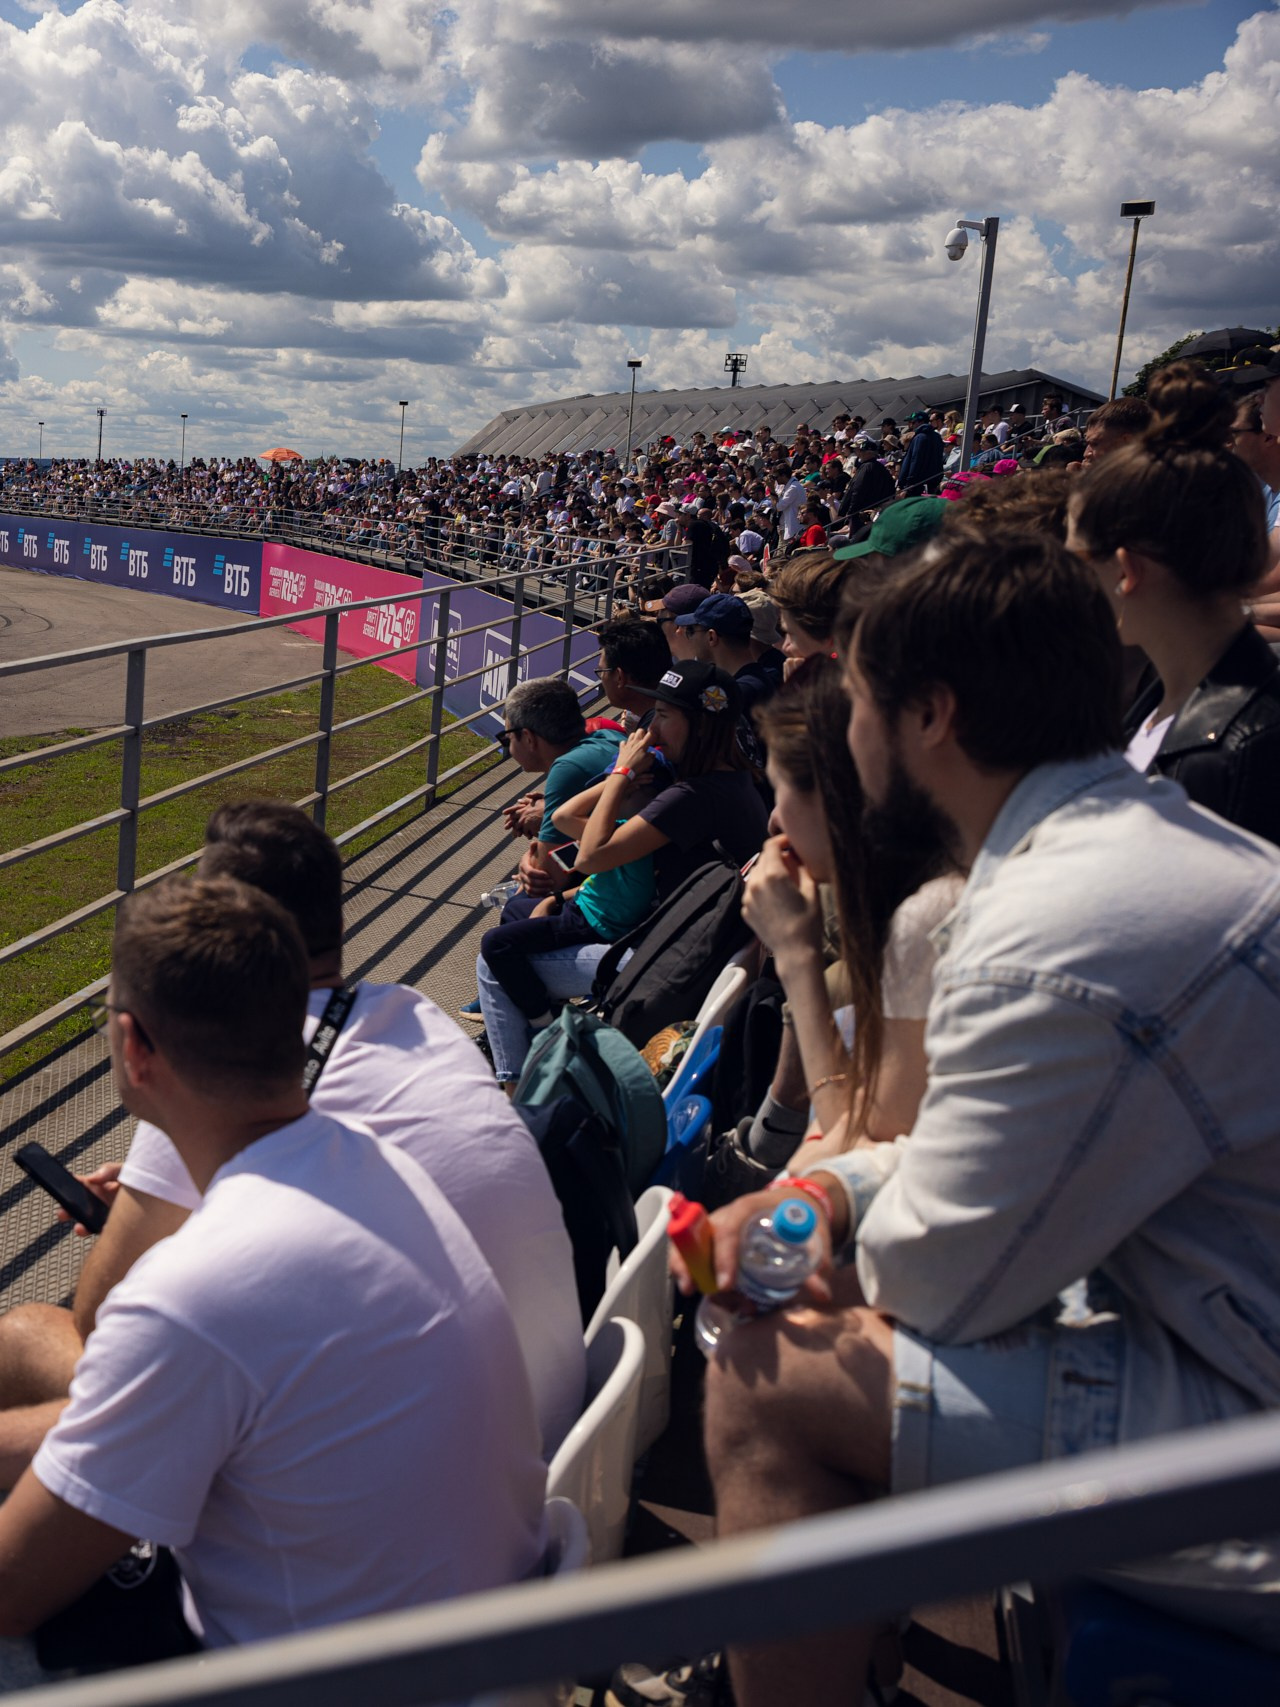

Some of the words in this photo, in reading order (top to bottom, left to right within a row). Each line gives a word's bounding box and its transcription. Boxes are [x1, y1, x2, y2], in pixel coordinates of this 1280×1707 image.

[23, 534, 38, 558] ВТБ
[53, 538, 70, 565] ВТБ
[90, 544, 108, 571] ВТБ
[128, 549, 149, 578] ВТБ
[173, 555, 196, 587] ВТБ
[224, 562, 250, 597] ВТБ
